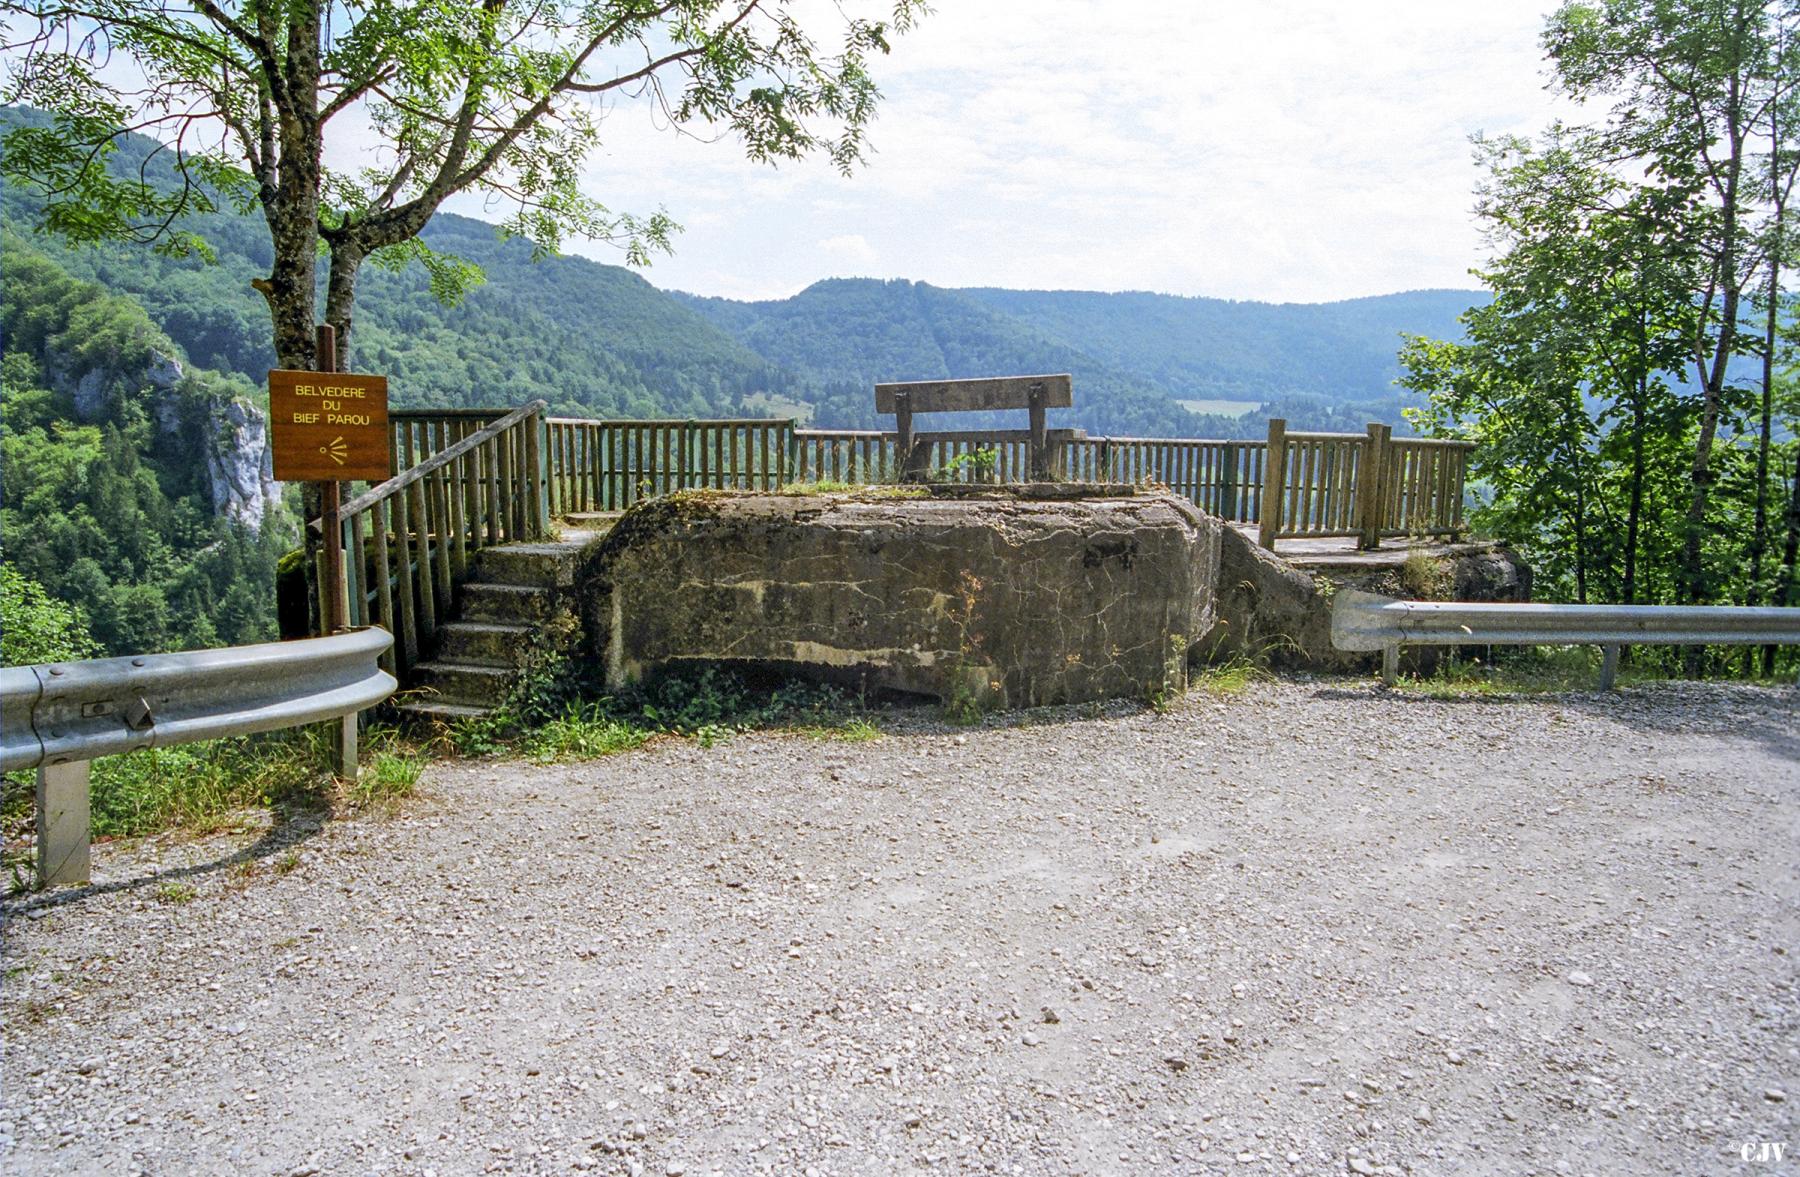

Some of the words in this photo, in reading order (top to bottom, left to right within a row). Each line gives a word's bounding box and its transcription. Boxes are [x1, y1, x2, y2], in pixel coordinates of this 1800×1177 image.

[296, 385, 365, 398] BELVEDERE
[323, 400, 341, 411] DU
[293, 413, 320, 423] BIEF
[328, 414, 370, 425] PAROU
